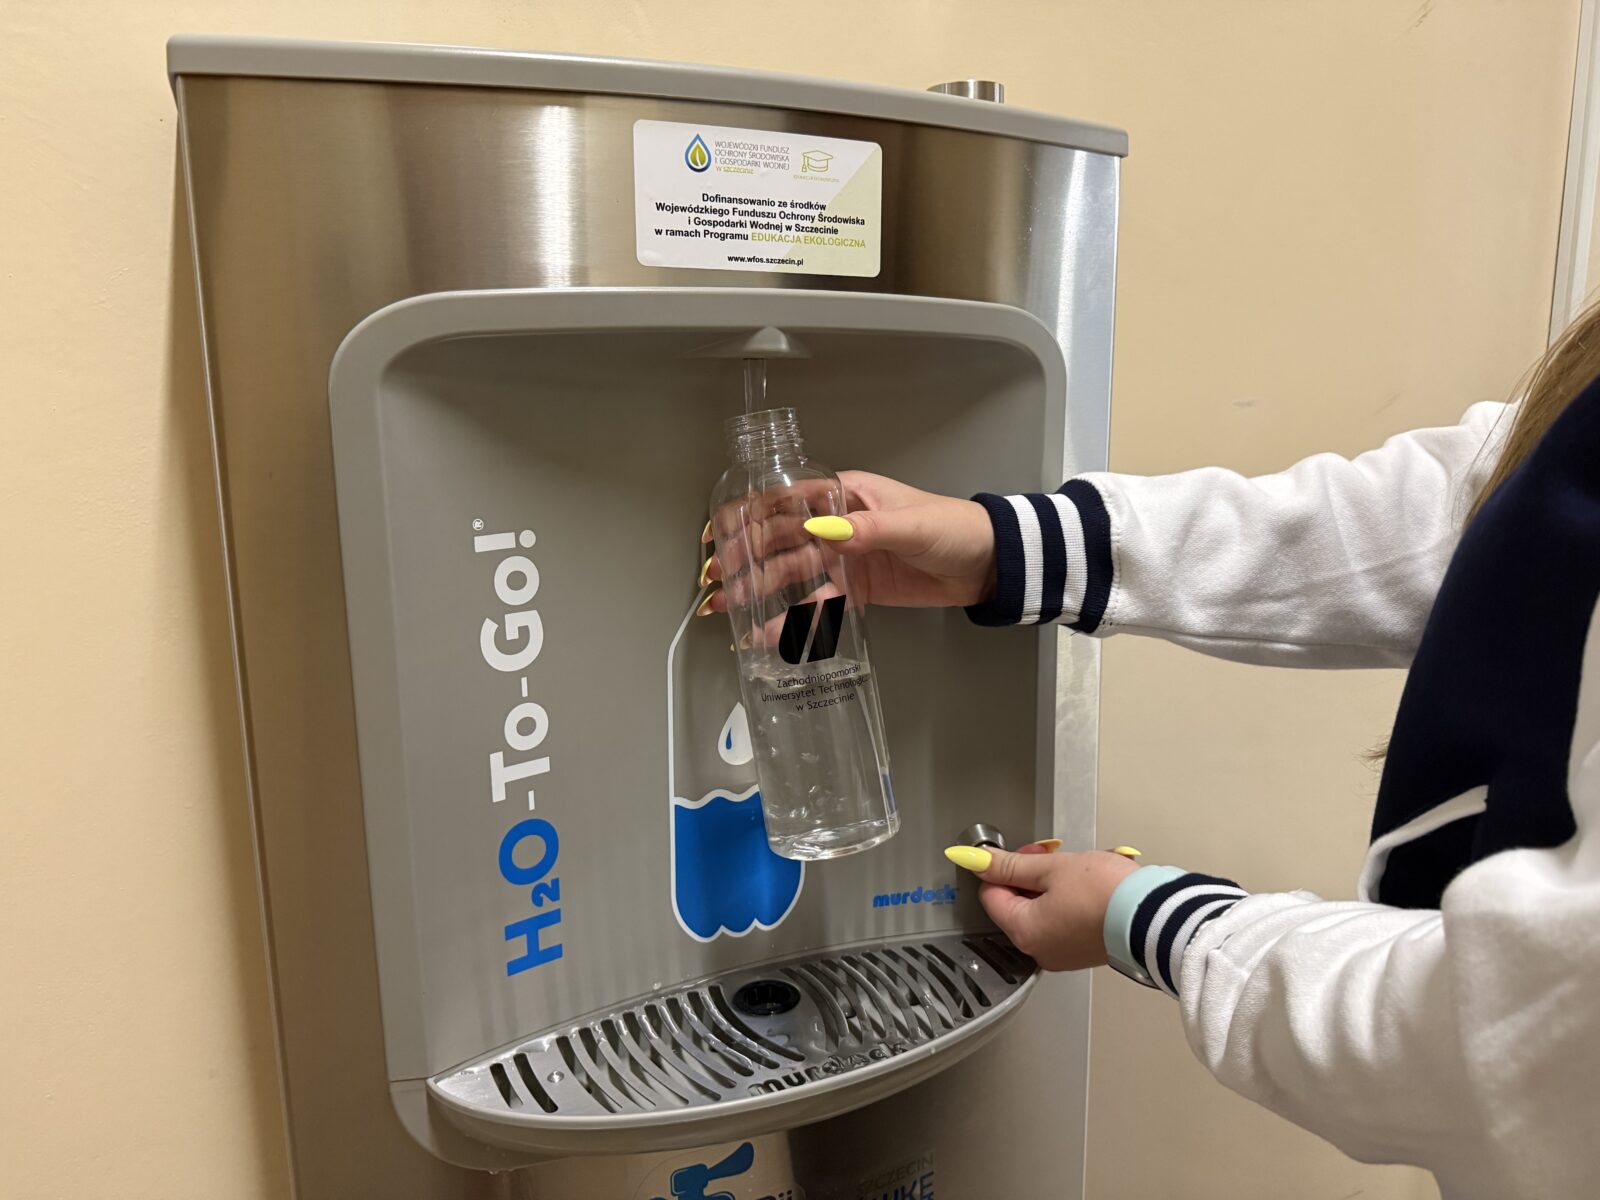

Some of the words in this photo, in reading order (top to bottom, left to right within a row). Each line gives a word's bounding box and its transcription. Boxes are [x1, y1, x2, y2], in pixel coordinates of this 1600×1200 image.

[715, 149, 747, 160] OCHRONY
[760, 144, 790, 154] FUNDUSZ
[720, 158, 761, 168] GOSPODARKI
[763, 162, 790, 171] WODNEJ
[778, 200, 788, 208] ze
[790, 199, 827, 211] środków
[655, 202, 730, 217] Wojewódzkiego
[732, 207, 777, 219] Funduszu
[779, 210, 816, 224] Ochrony
[817, 211, 866, 226] Środowiska
[687, 216, 692, 226] i
[693, 216, 748, 230] Gospodarki
[750, 220, 783, 233] Wodnej
[785, 224, 793, 232] w
[794, 223, 839, 236] Szczecinie
[654, 228, 664, 236] w
[665, 227, 701, 239] ramach
[703, 230, 749, 242] Programu
[751, 232, 802, 245] EDUKACJA
[804, 235, 866, 249] EKOLOGICZNA
[727, 254, 804, 267] www.wfos.szczecin.pl
[777, 664, 861, 689] Zachodniopomorski
[761, 687, 816, 703] Uniwersytet
[795, 703, 804, 712] w
[807, 692, 855, 710] Szczecinie
